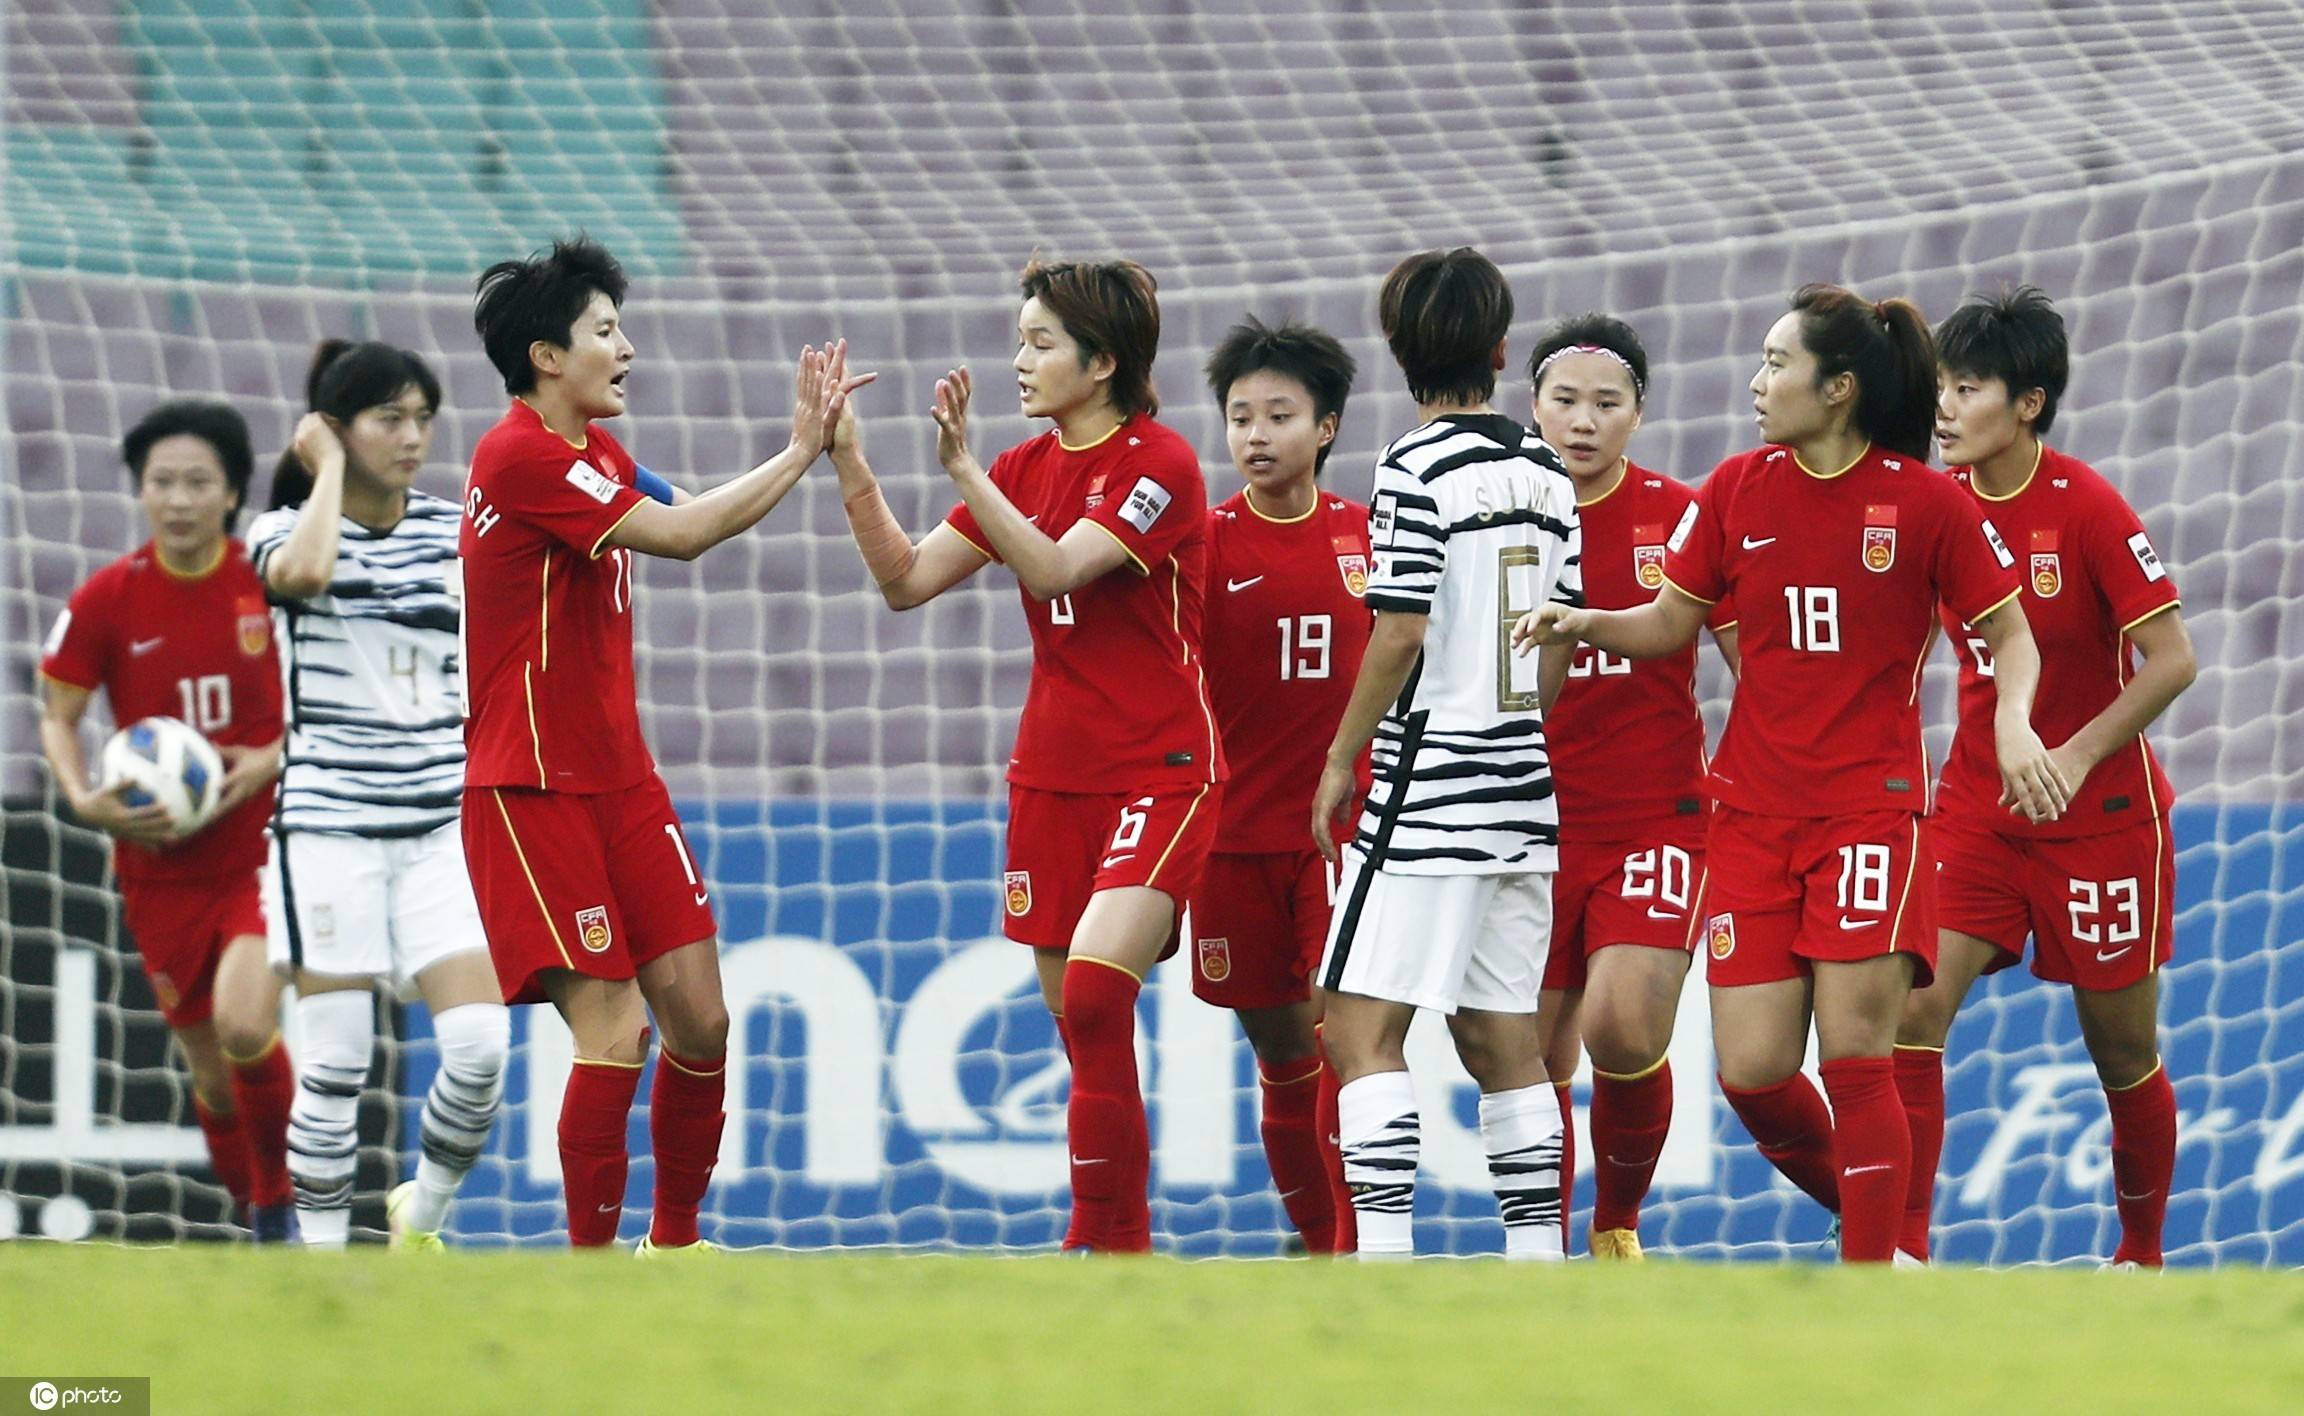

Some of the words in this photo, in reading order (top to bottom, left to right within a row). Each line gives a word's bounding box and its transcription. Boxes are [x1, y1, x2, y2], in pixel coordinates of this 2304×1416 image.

[1277, 614, 1332, 680] 19
[1784, 586, 1840, 652] 18
[177, 674, 232, 732] 10
[389, 644, 419, 706] 4
[1110, 796, 1155, 851] 6
[1621, 844, 1691, 911] 20
[1837, 843, 1890, 911] 18
[2068, 876, 2141, 943] 23
